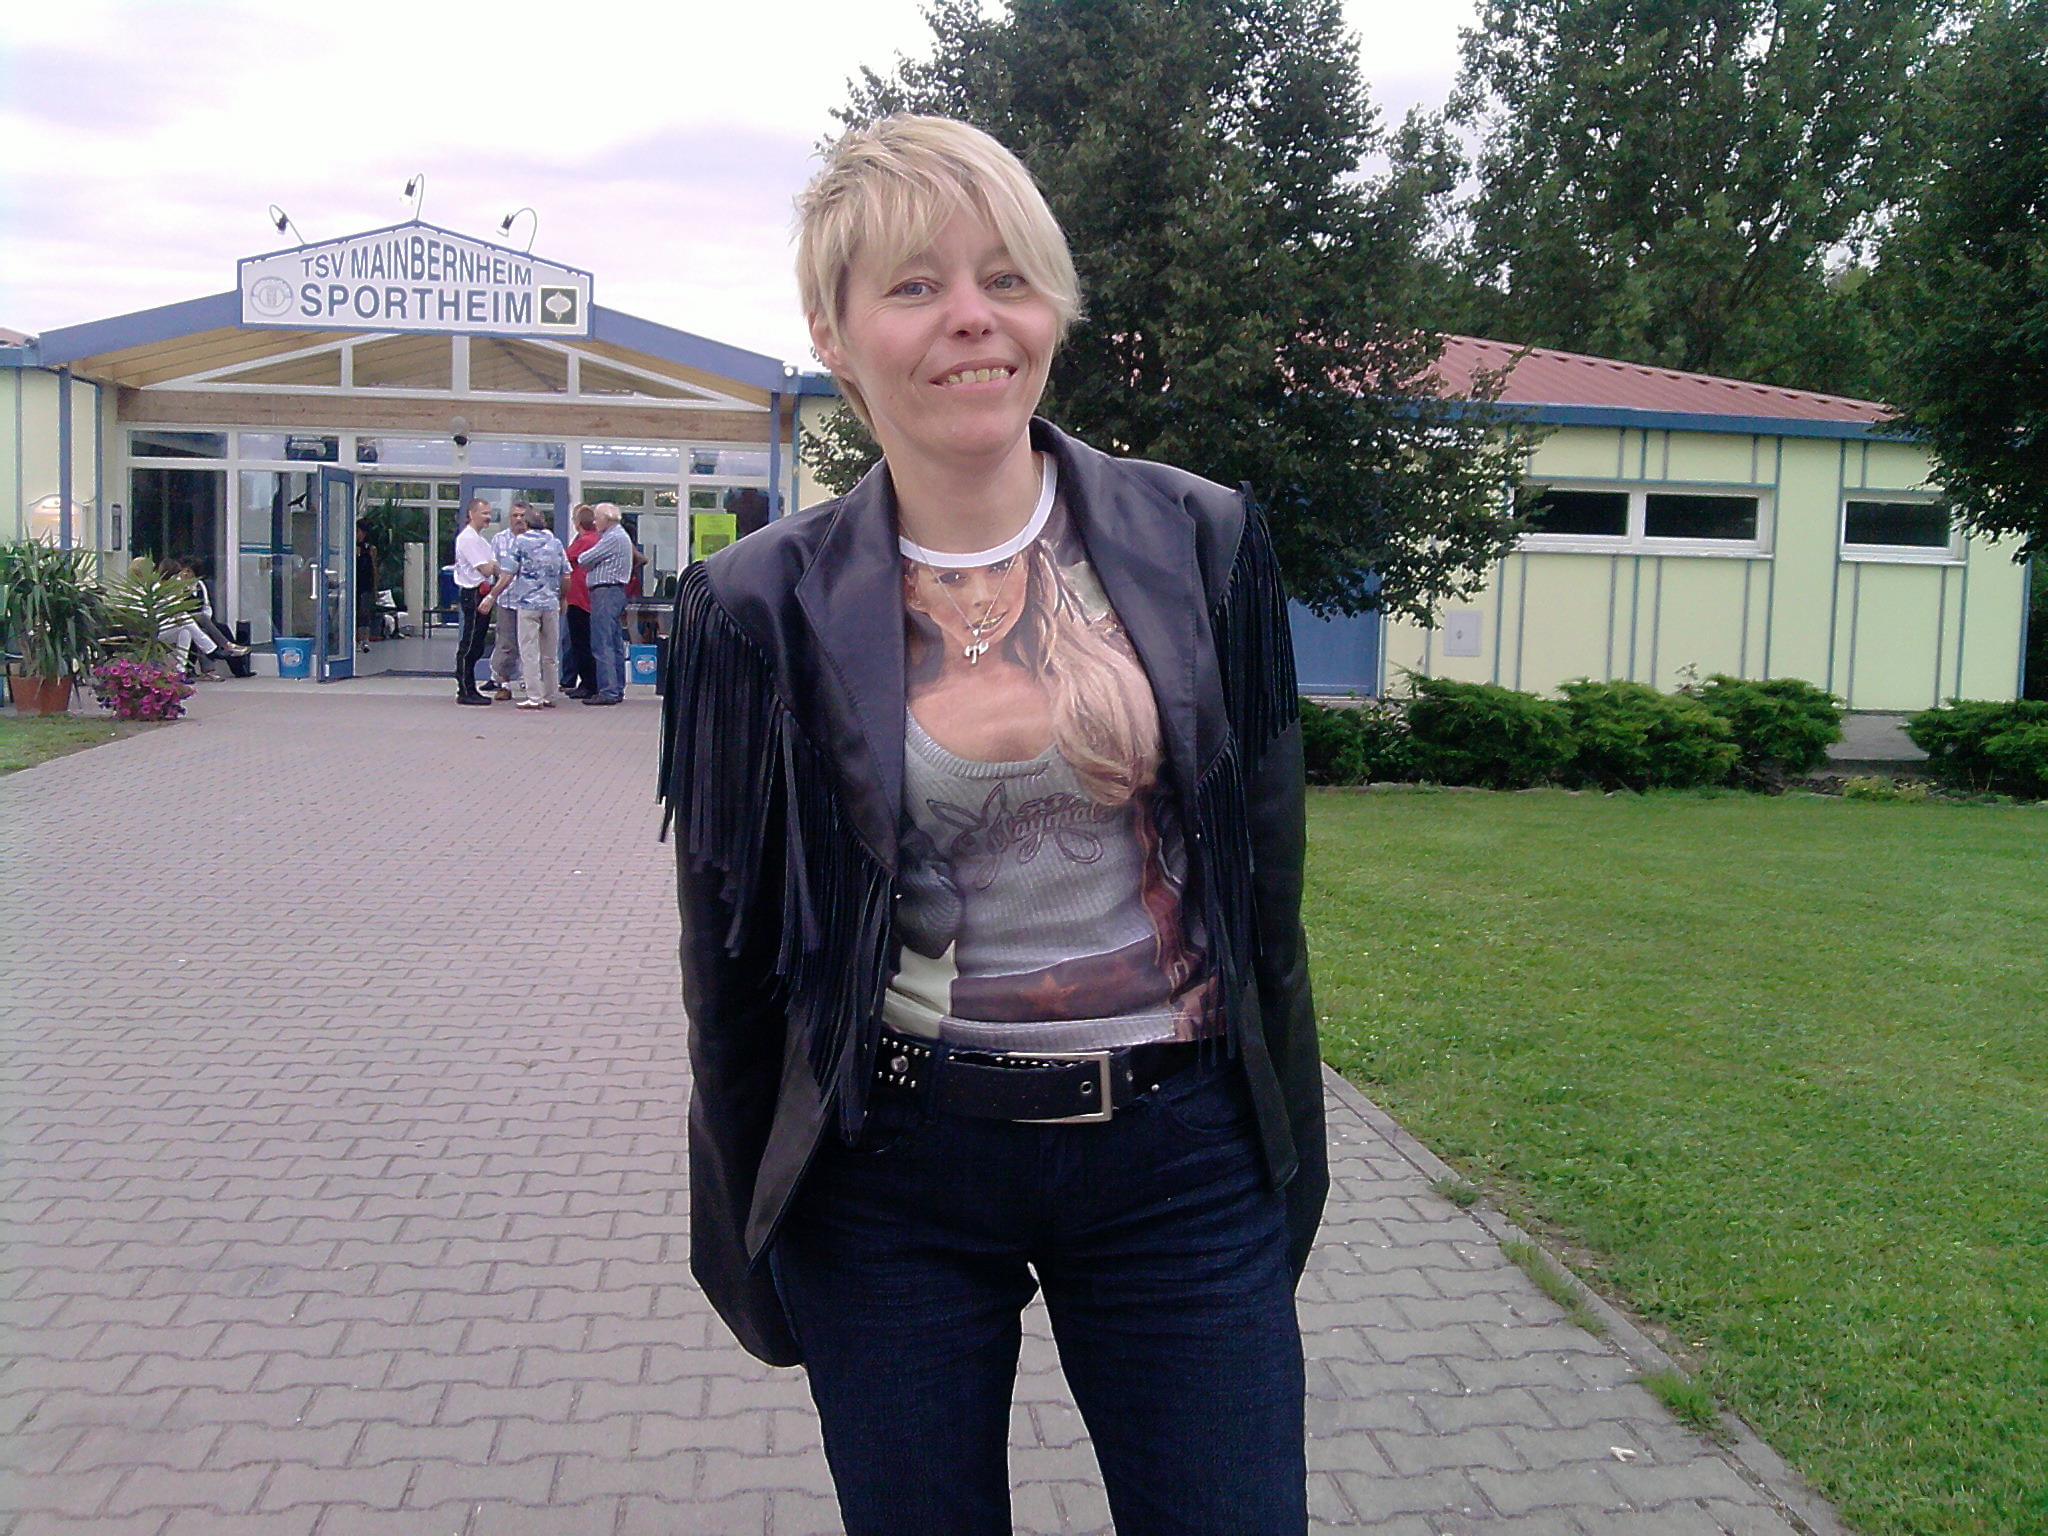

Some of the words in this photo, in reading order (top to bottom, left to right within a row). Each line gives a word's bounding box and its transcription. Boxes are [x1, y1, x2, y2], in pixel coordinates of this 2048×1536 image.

[300, 250, 345, 278] TSV
[351, 235, 533, 286] MAINBERNHEIM
[300, 283, 533, 324] SPORTHEIM
